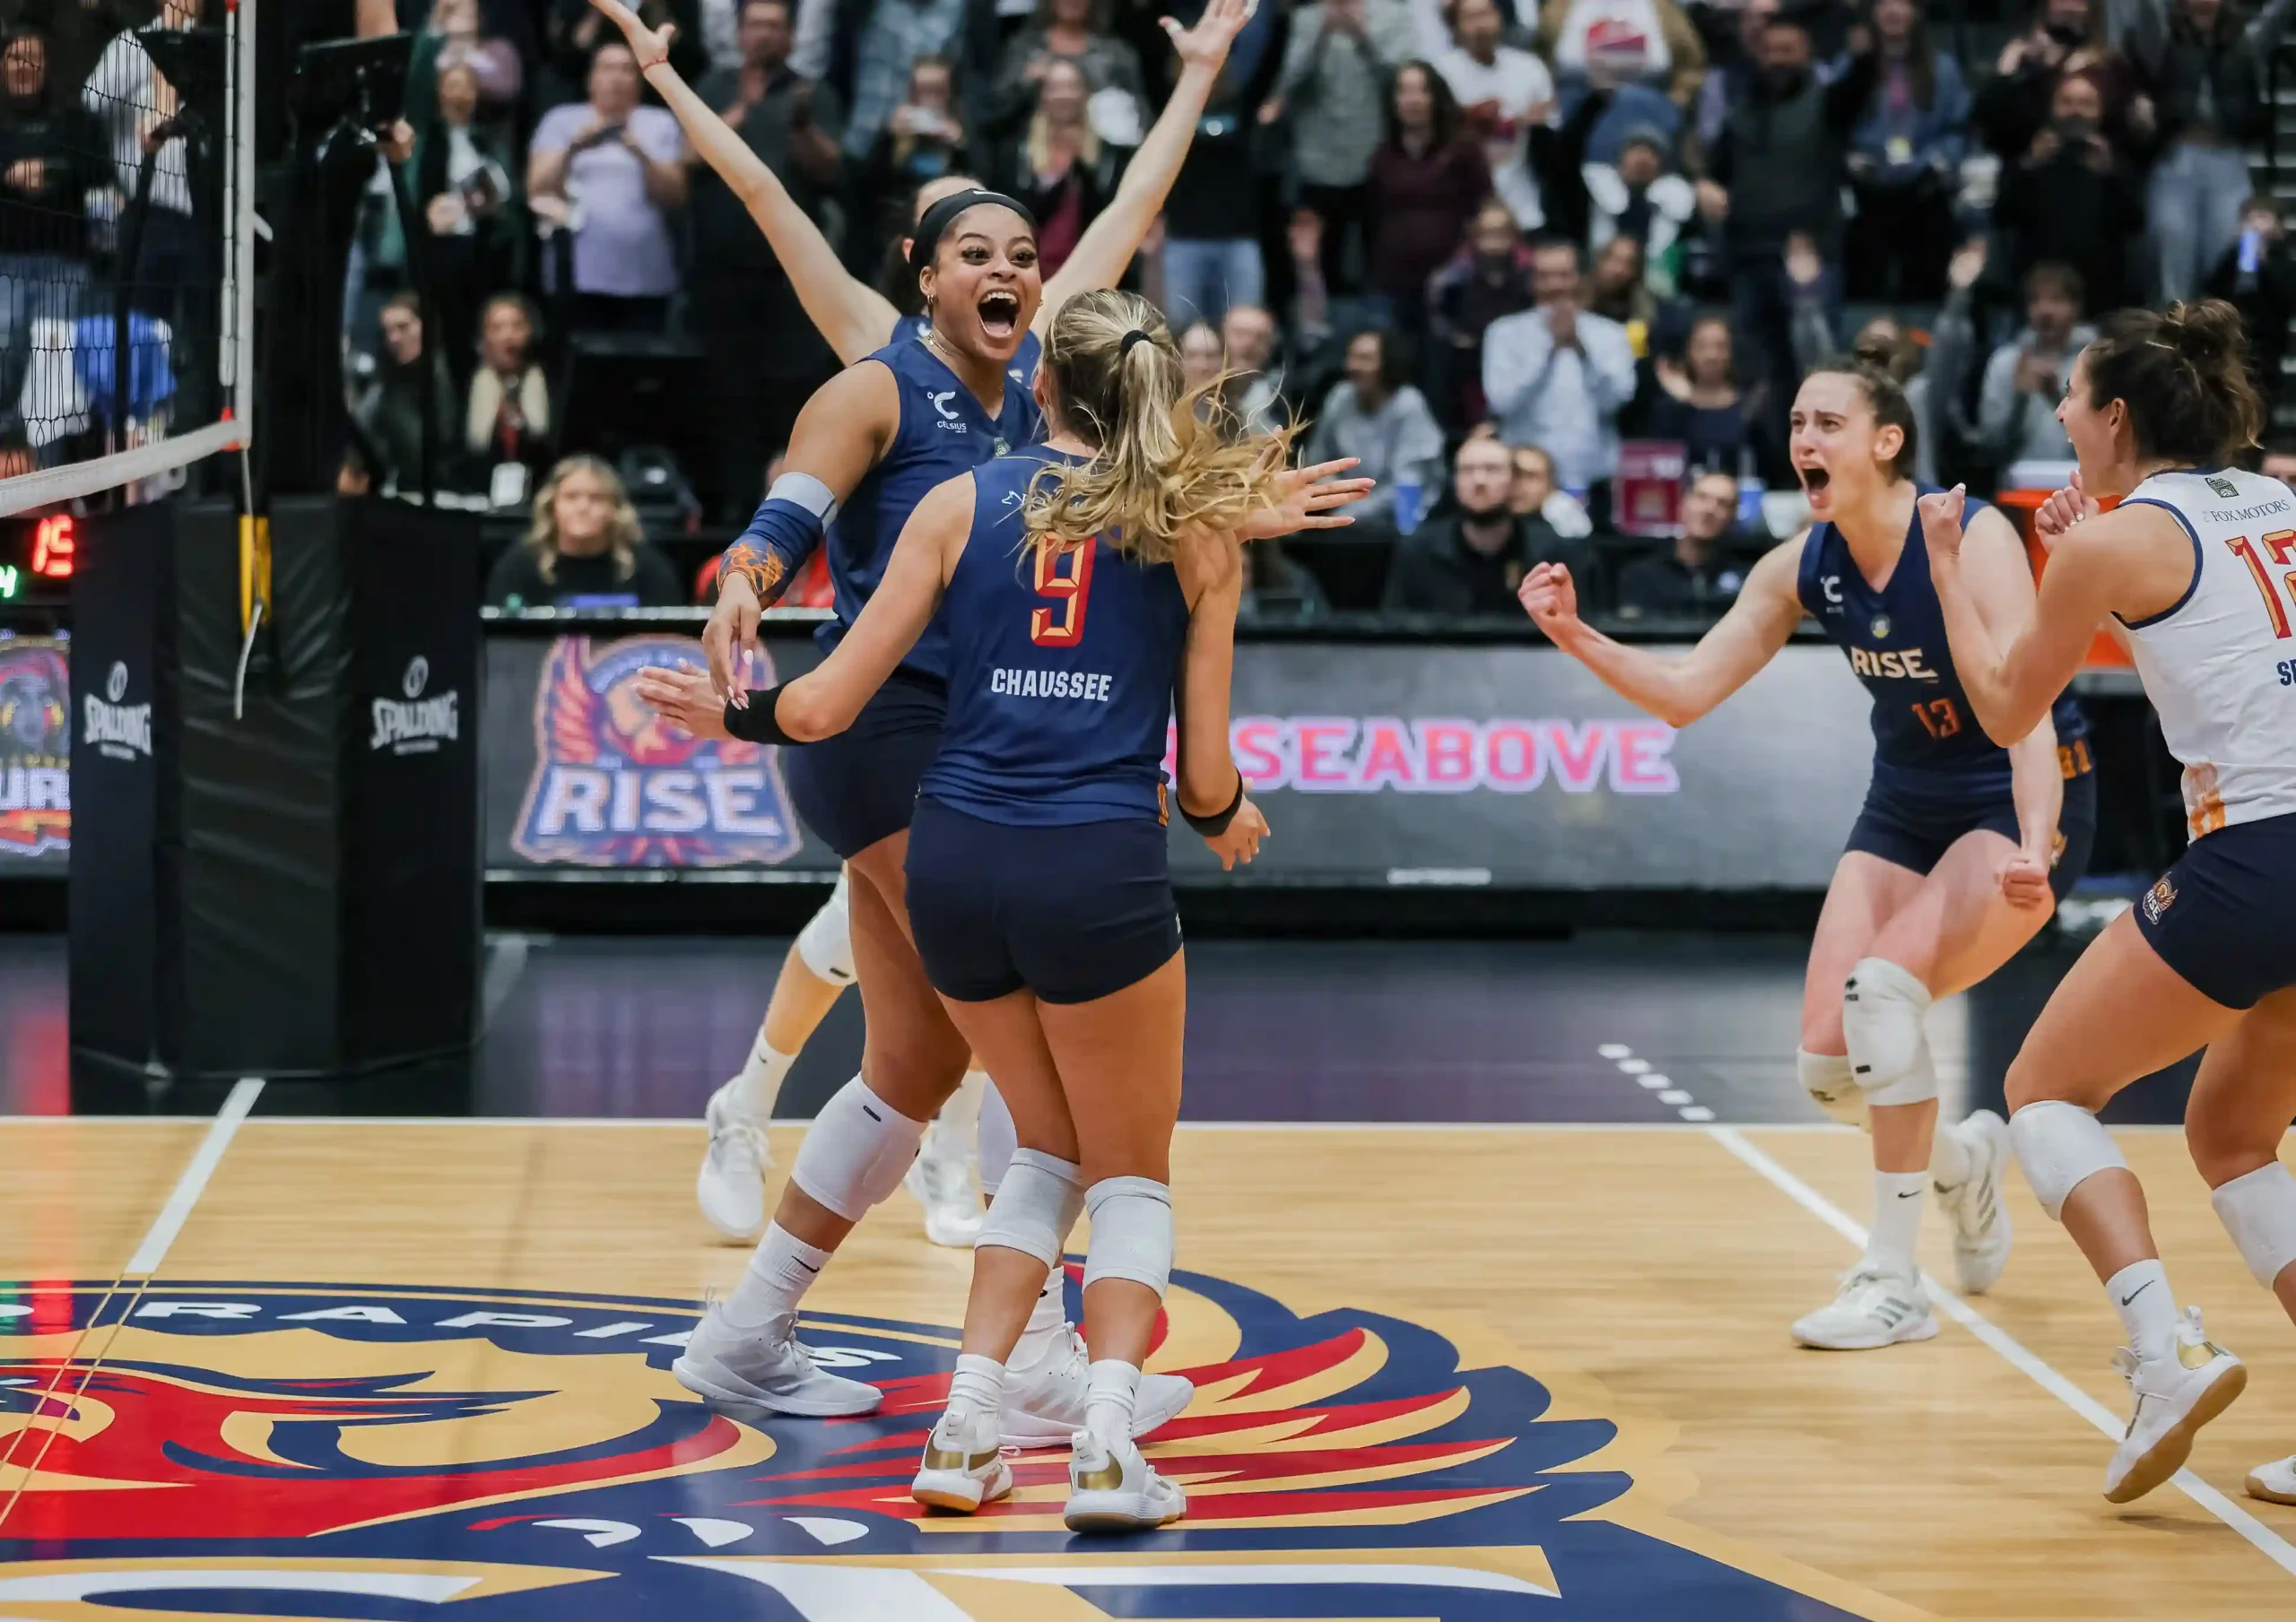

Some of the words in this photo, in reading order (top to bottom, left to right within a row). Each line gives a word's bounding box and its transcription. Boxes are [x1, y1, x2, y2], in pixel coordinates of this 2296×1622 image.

[936, 421, 967, 430] CELSIUS
[2210, 509, 2239, 522] FOX
[2236, 499, 2291, 521] MOTORS
[32, 514, 74, 577] 15
[1030, 529, 1097, 647] 9
[990, 667, 1113, 702] CHAUSSEE
[1850, 645, 1940, 680] RISE
[83, 693, 153, 757] SPALDING
[370, 690, 458, 750] SPALDING
[1911, 698, 1962, 739] 13
[536, 764, 783, 836] RISE
